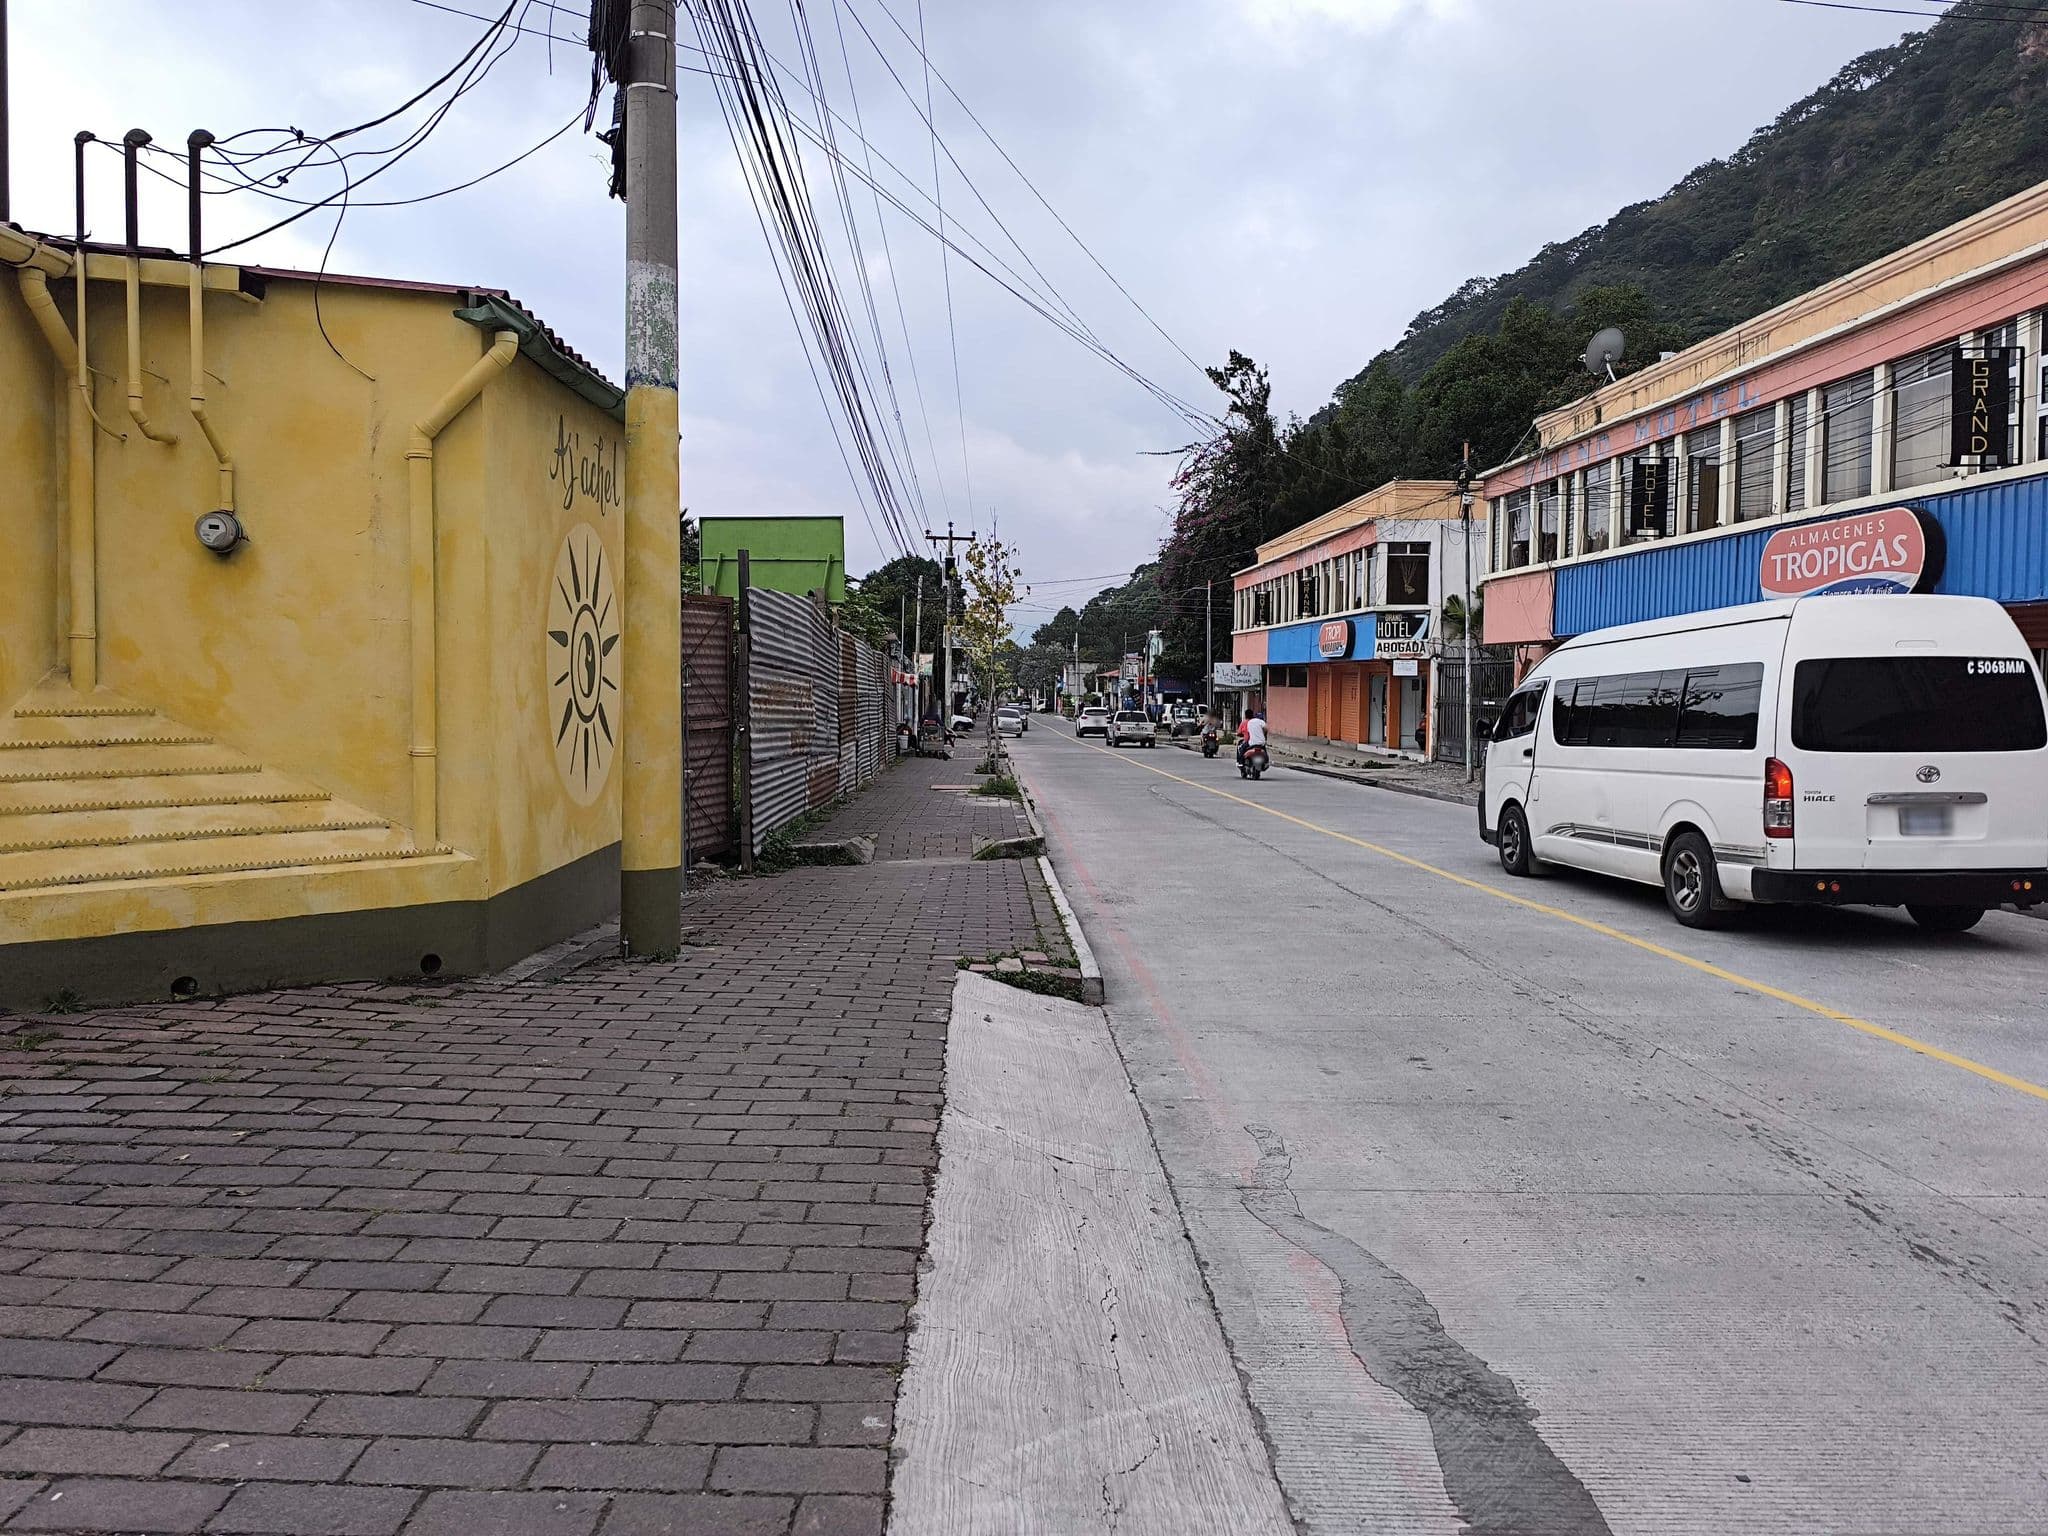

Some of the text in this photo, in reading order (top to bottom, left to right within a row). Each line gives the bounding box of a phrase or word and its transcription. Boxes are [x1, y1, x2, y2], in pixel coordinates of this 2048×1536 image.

[1634, 378, 1760, 447] HOTEL
[1971, 359, 1989, 453] GRAND
[1643, 465, 1657, 530] HOTEL
[1789, 519, 1886, 548] ALMACENES
[1771, 534, 1908, 583] TROPIGAS
[1377, 621, 1412, 638] HOTEL
[1377, 641, 1426, 653] ABOGADA
[1967, 660, 2026, 674] C 506BMM
